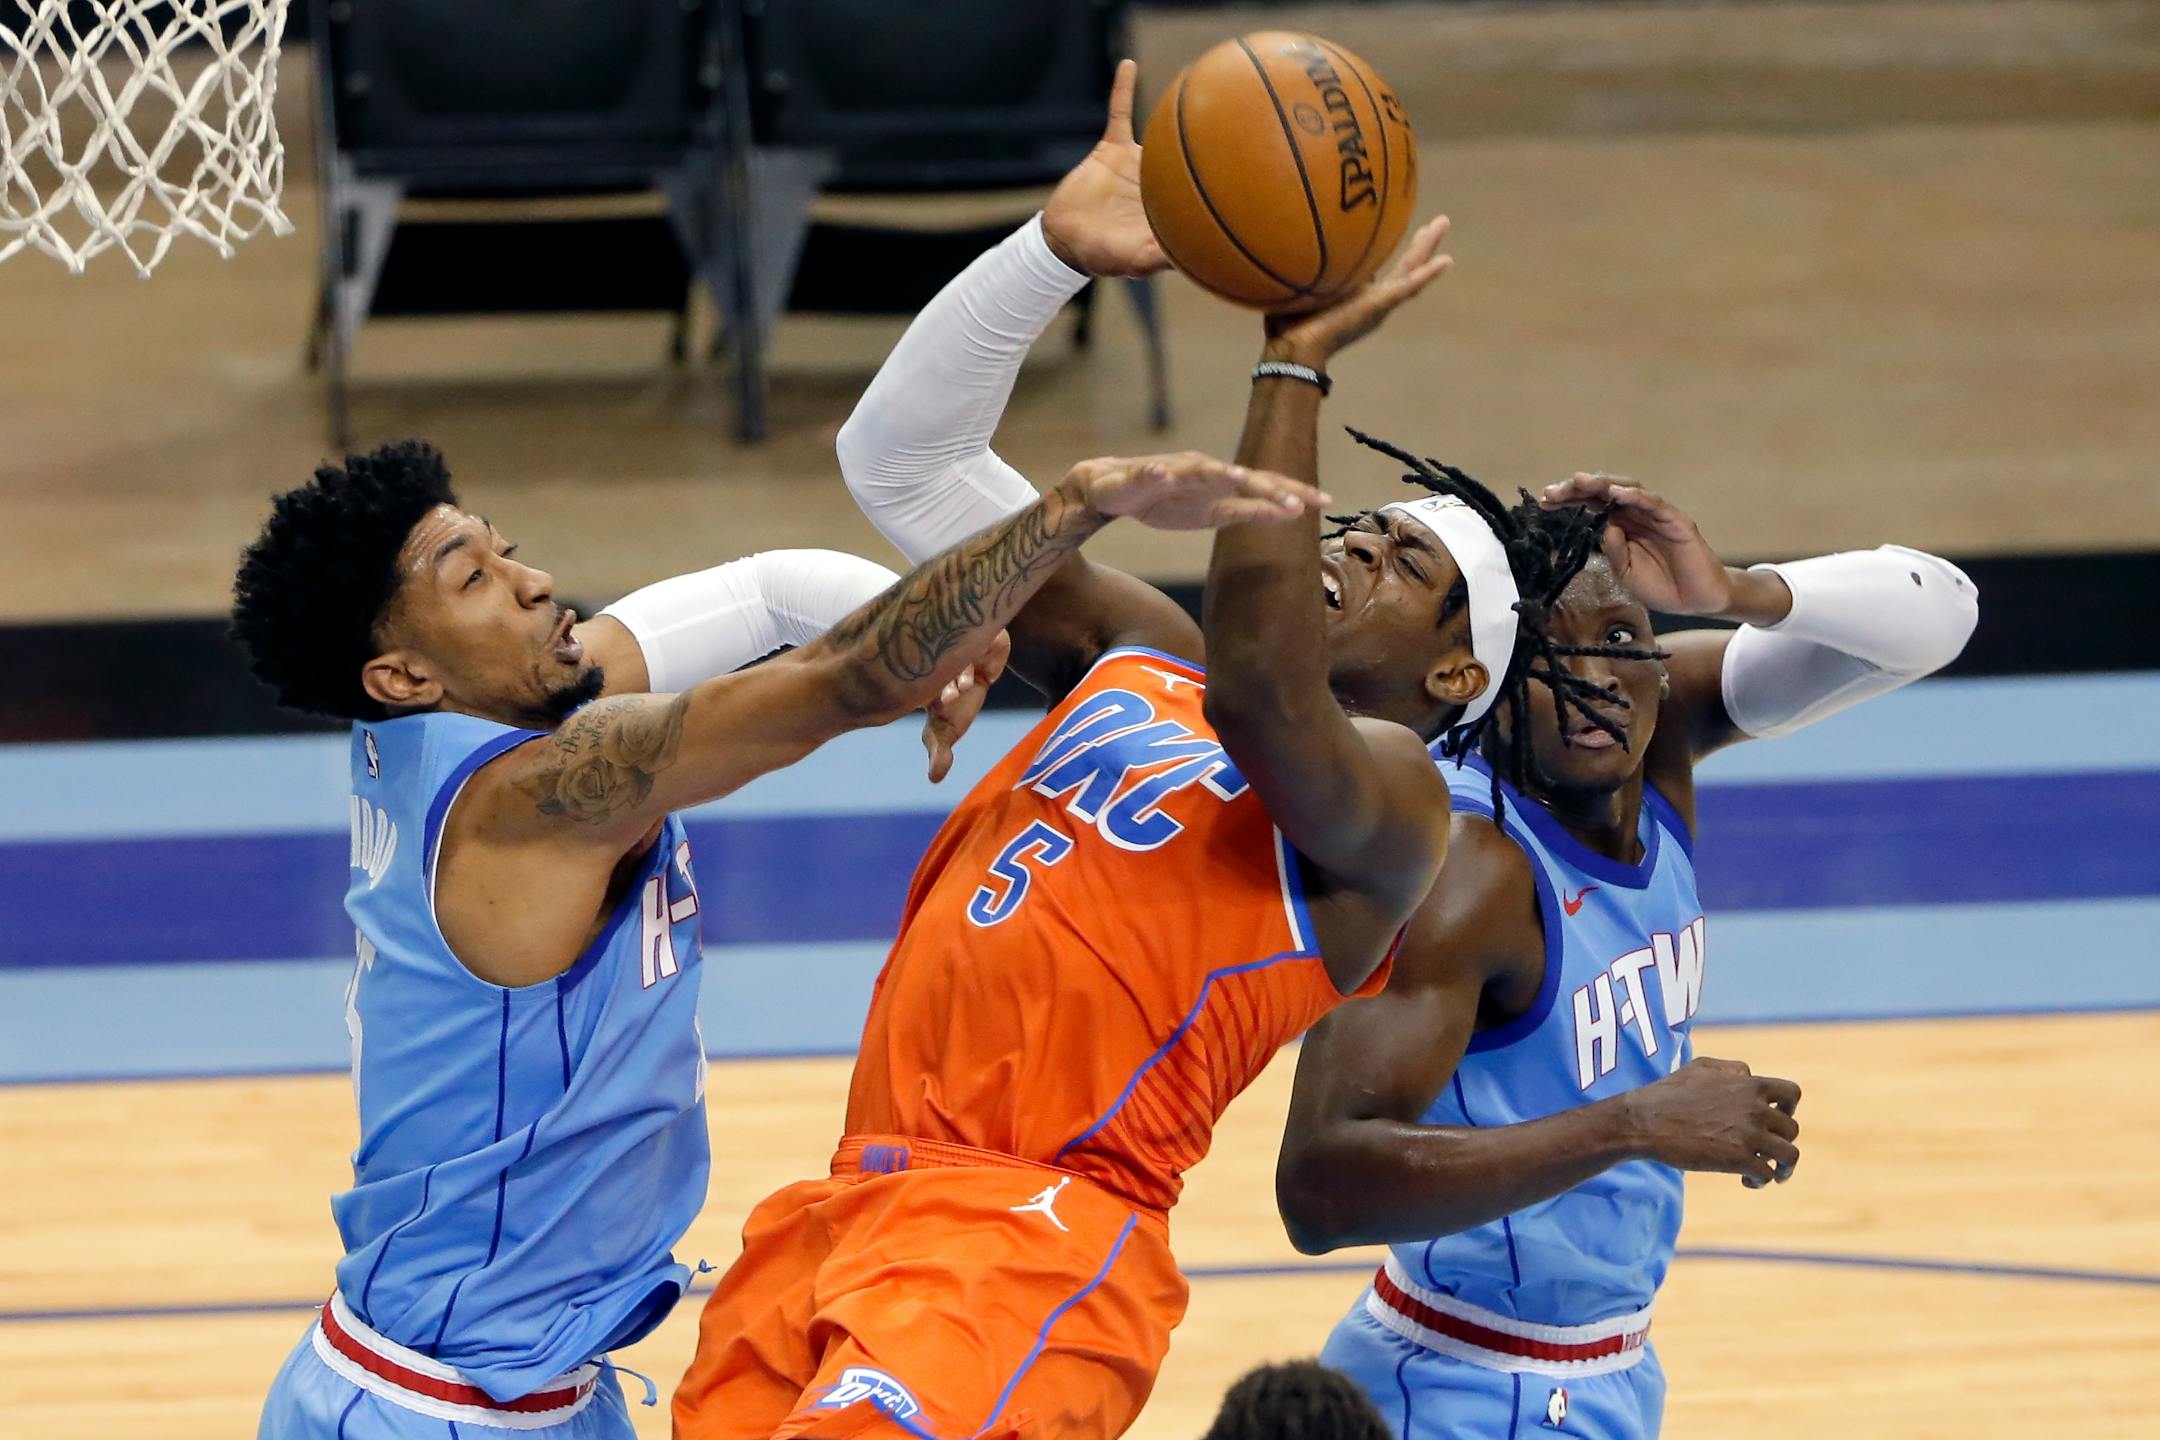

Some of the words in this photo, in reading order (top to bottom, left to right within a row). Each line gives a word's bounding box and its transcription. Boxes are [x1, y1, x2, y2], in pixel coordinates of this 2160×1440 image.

[1294, 42, 1377, 212] SPALDIN
[1012, 688, 1251, 852] OKC
[966, 818, 1075, 928] 5
